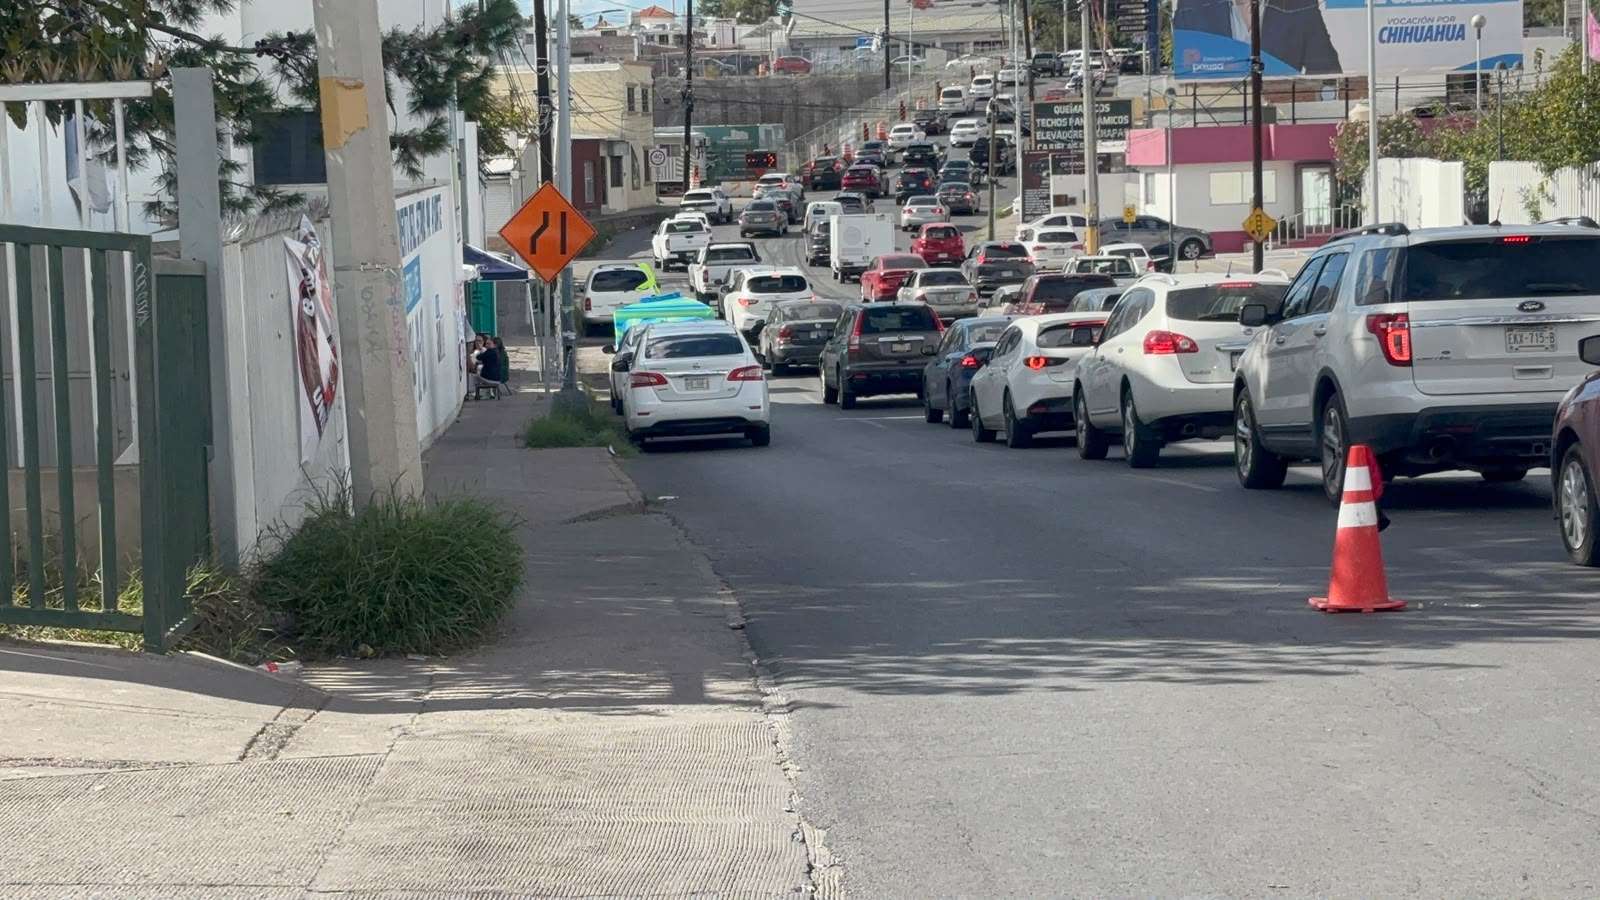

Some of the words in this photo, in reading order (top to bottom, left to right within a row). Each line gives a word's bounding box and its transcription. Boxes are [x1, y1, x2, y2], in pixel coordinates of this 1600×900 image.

[1387, 15, 1434, 25] VOCACIÓN
[1436, 15, 1456, 24] POR
[1378, 24, 1466, 44] CHIHUAHUA
[1053, 103, 1111, 115] QUEMACOS
[1036, 118, 1067, 128] TECHOS
[1068, 115, 1129, 127] PANAMICOS
[1036, 130, 1085, 140] ELEVADORE
